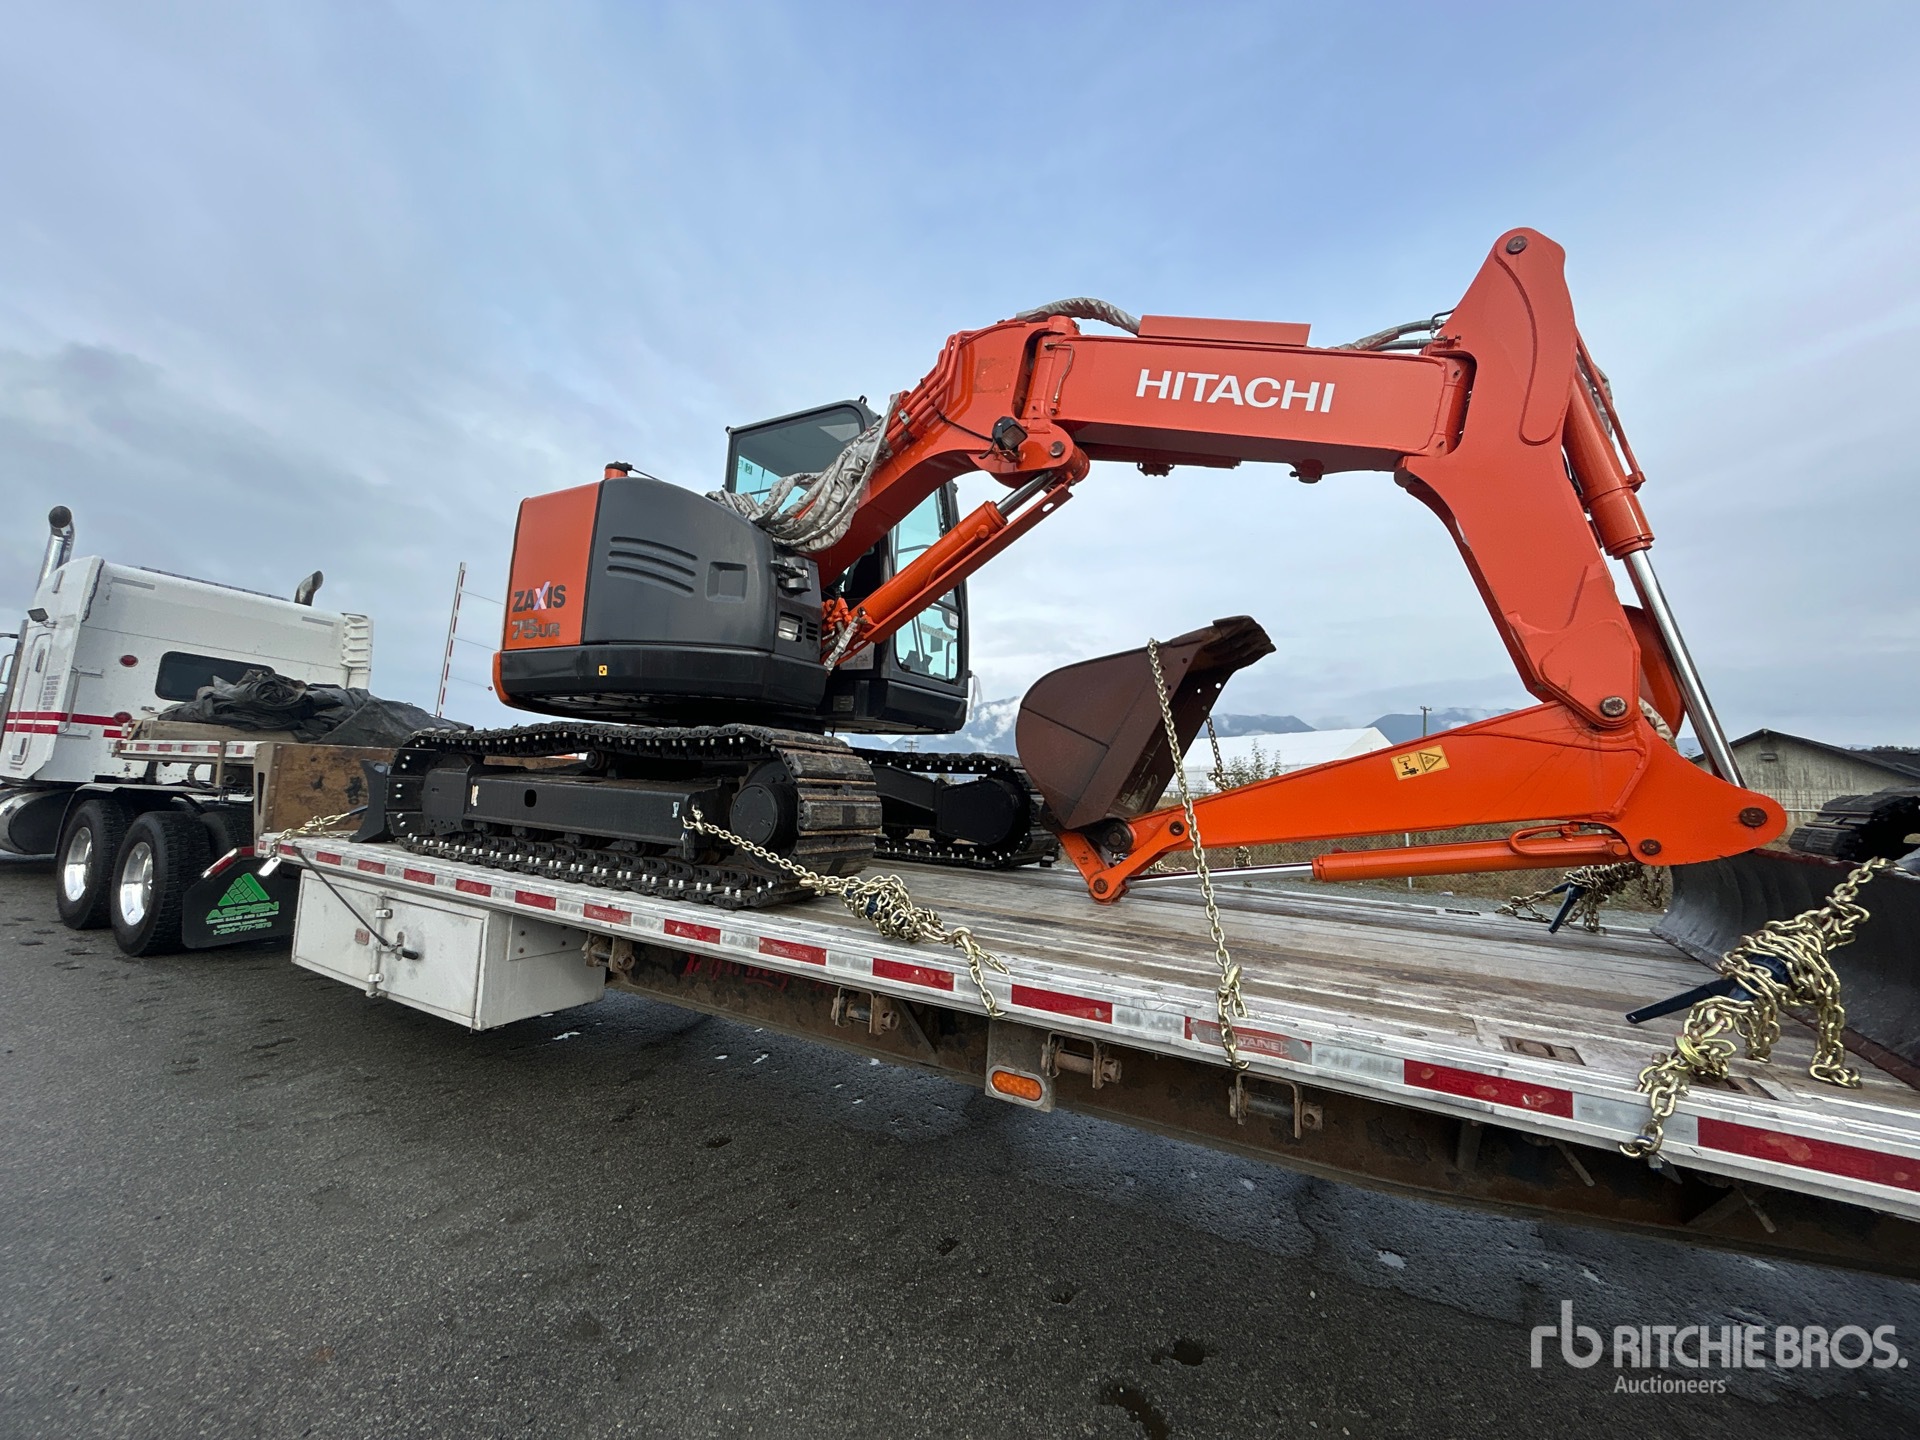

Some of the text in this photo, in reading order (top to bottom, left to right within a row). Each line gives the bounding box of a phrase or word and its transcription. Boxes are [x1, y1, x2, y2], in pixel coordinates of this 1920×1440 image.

[1136, 369, 1335, 413] HITACHI
[512, 581, 566, 612] ZAXIS
[206, 901, 279, 920] ASPEN
